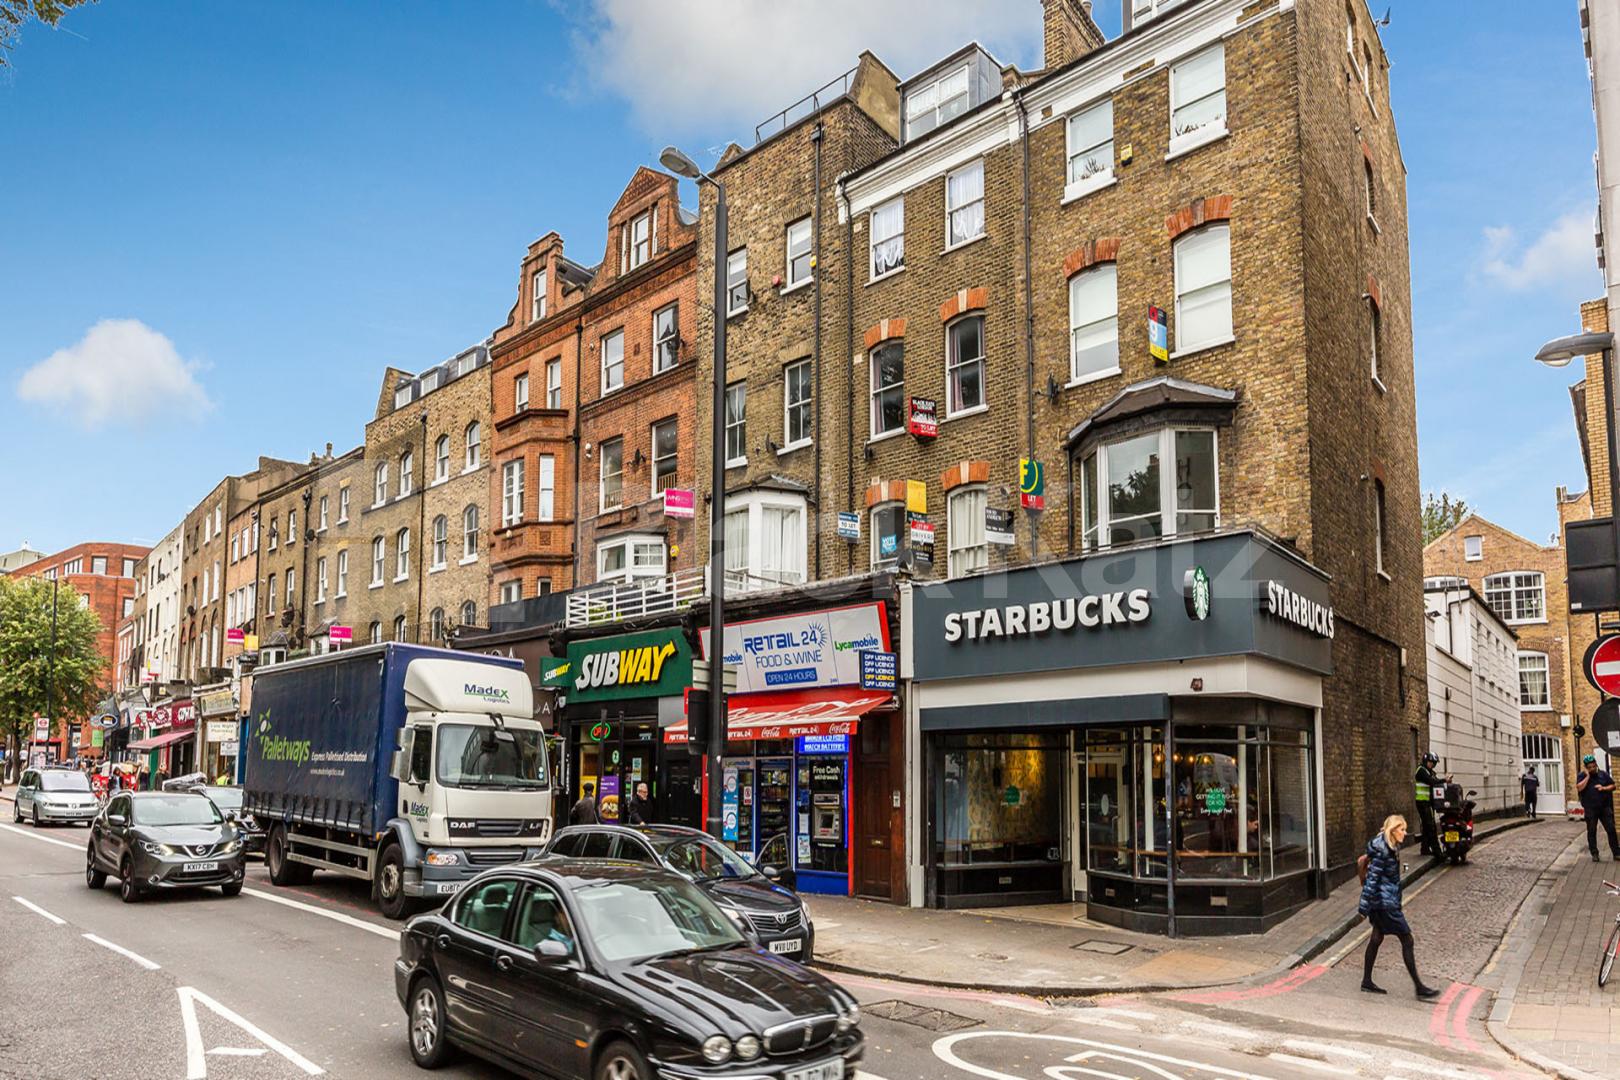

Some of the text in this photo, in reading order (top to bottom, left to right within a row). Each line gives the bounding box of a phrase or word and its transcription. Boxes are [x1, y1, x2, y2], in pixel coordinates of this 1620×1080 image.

[944, 589, 1150, 642] STARBUCKS
[1267, 579, 1335, 640] STARBUCKS
[801, 630, 818, 646] 24
[834, 637, 878, 651] Lycamobile
[575, 640, 676, 691] SUBWAY
[756, 649, 822, 668] FOOD & WINE
[543, 662, 571, 681] SUBWAY
[767, 670, 815, 683] OPEN 24 HOURS
[262, 735, 311, 768] Palletways
[812, 766, 840, 774] Free Cash
